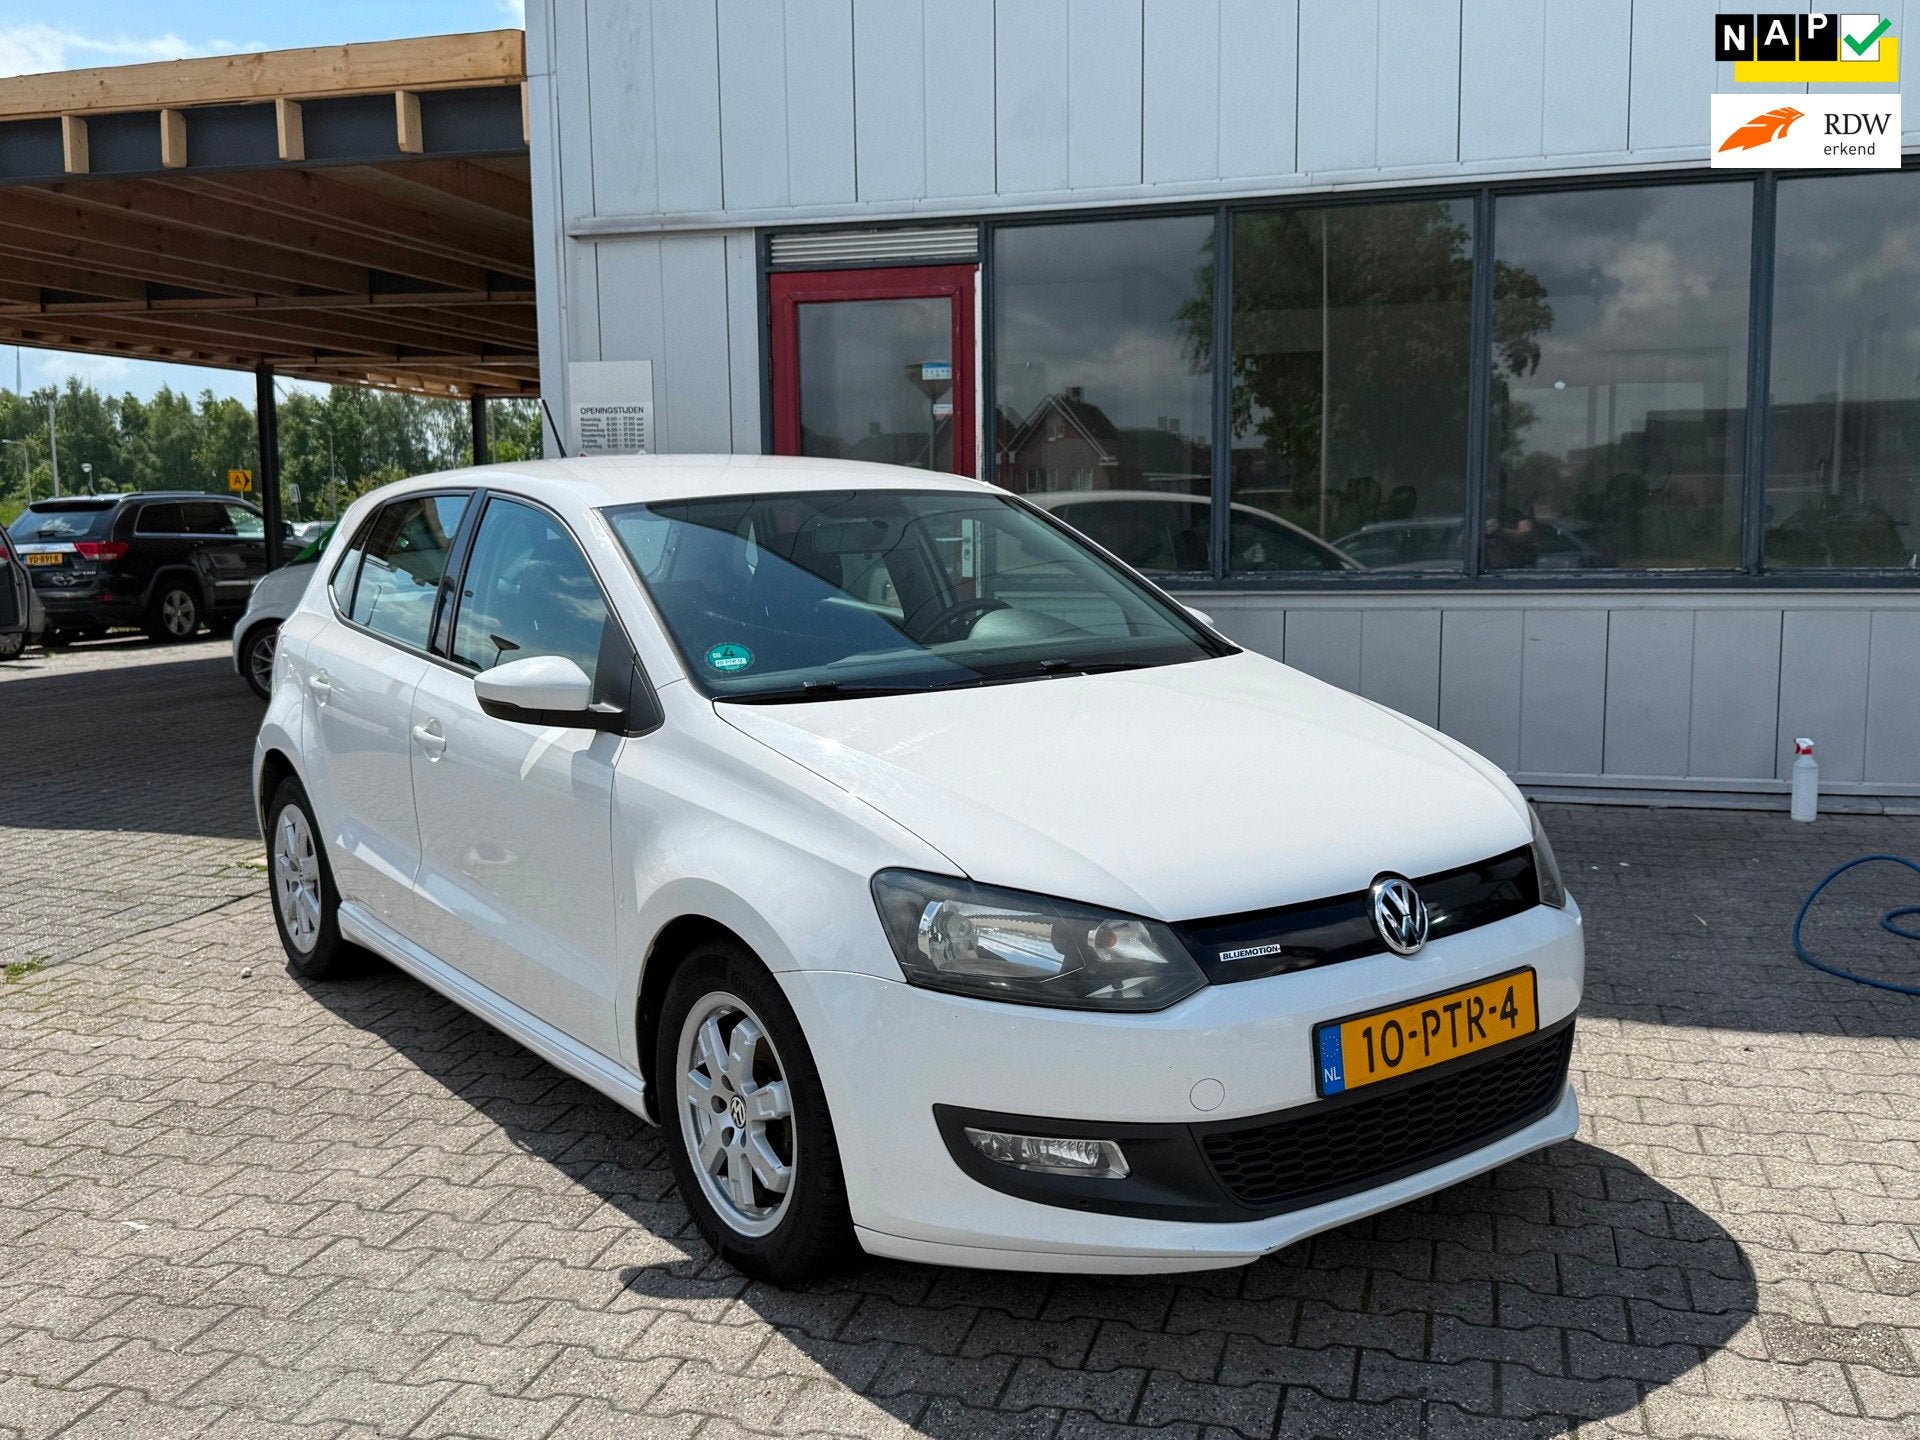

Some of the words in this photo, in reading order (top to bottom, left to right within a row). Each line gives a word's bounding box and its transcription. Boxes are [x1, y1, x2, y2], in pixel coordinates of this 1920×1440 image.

[580, 406, 644, 415] OPENINGSTIJDEN
[234, 475, 242, 486] A
[723, 645, 735, 657] 4
[1222, 945, 1278, 960] BLUEMOTION
[1362, 985, 1518, 1073] 10-PTR-4
[1324, 1067, 1342, 1083] NL
